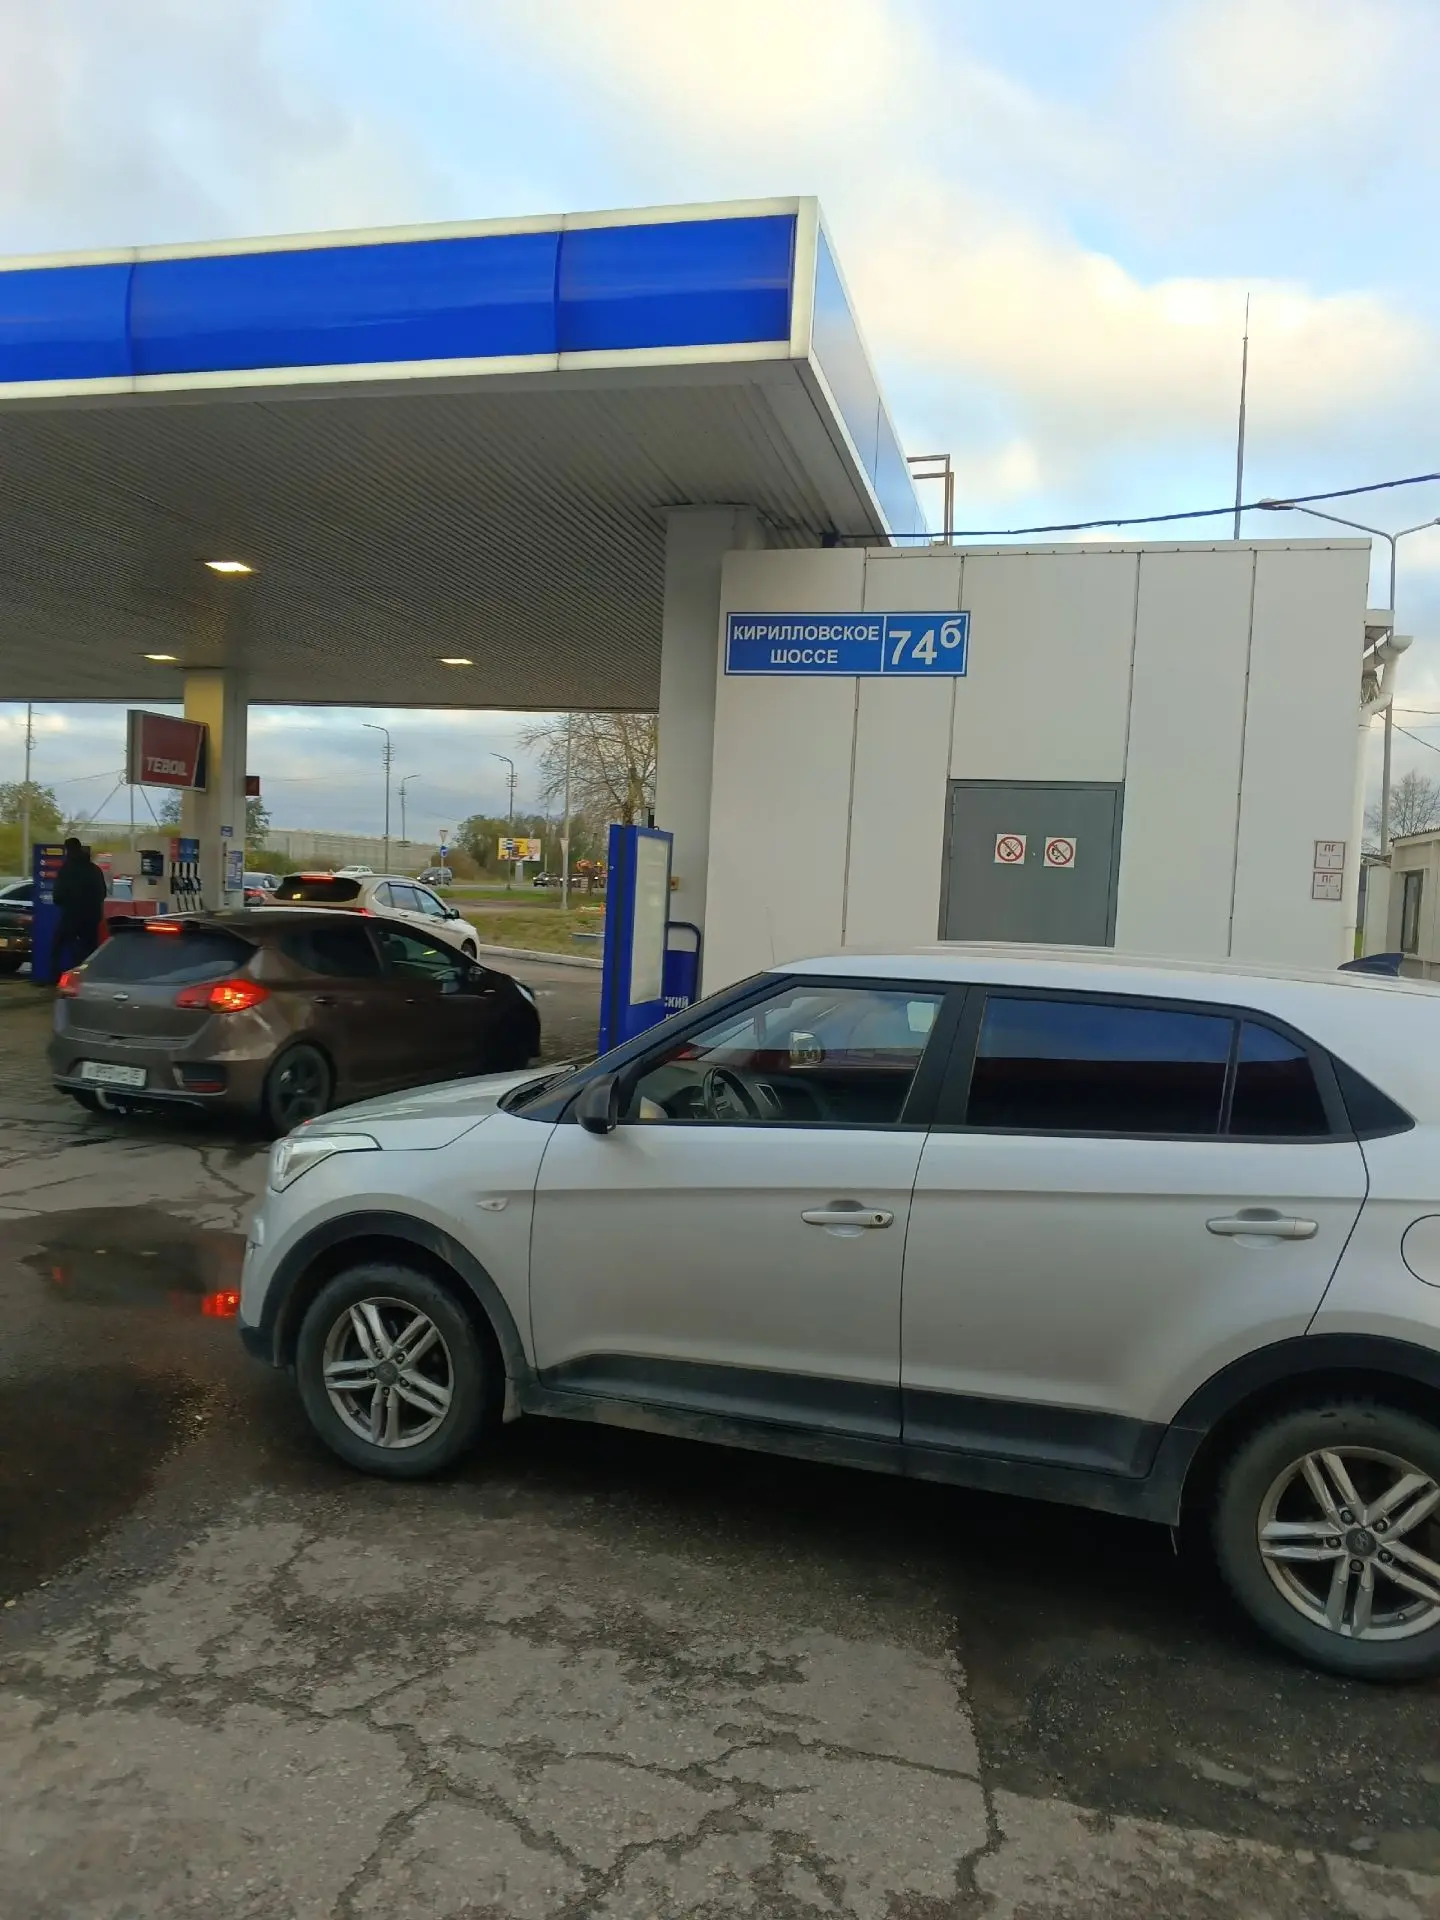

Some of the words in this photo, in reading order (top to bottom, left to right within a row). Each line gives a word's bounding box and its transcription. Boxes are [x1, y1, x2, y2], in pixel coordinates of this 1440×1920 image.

[733, 625, 880, 641] КИРИЛЛОВСКОЕ
[888, 618, 962, 665] 74б
[770, 648, 839, 664] ШОССЕ
